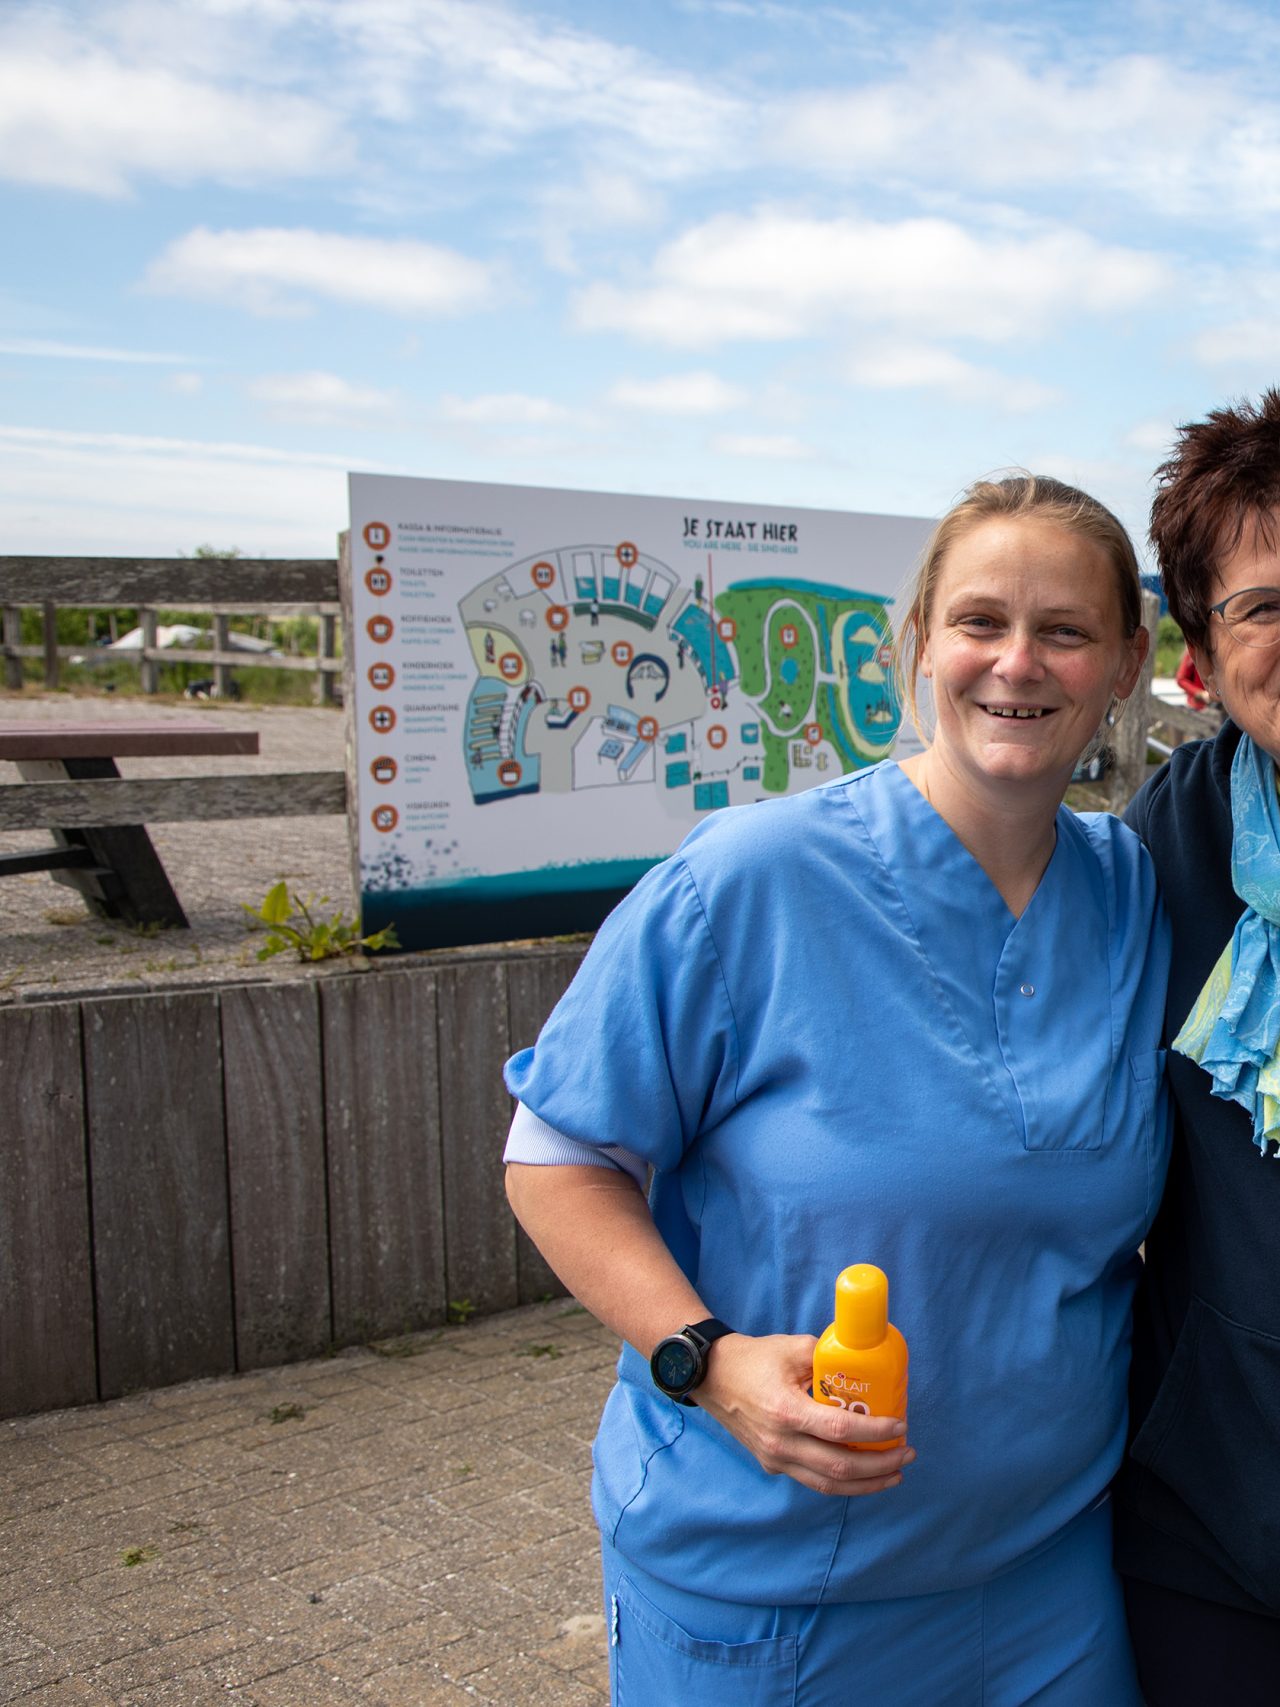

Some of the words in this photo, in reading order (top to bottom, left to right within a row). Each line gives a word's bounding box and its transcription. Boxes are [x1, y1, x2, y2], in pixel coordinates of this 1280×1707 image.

[683, 517, 699, 537] JE
[706, 519, 756, 539] STAAT
[763, 523, 798, 542] HIER
[683, 540, 701, 549] YOU
[703, 541, 718, 550] ARE
[721, 542, 742, 551] HERE
[400, 567, 443, 577] TOILETTEN
[401, 615, 451, 623] KOFFIEHOEK
[403, 703, 459, 712] QUARANTAINE
[404, 754, 436, 762] CINEMA
[825, 1374, 871, 1393] SOLAIT
